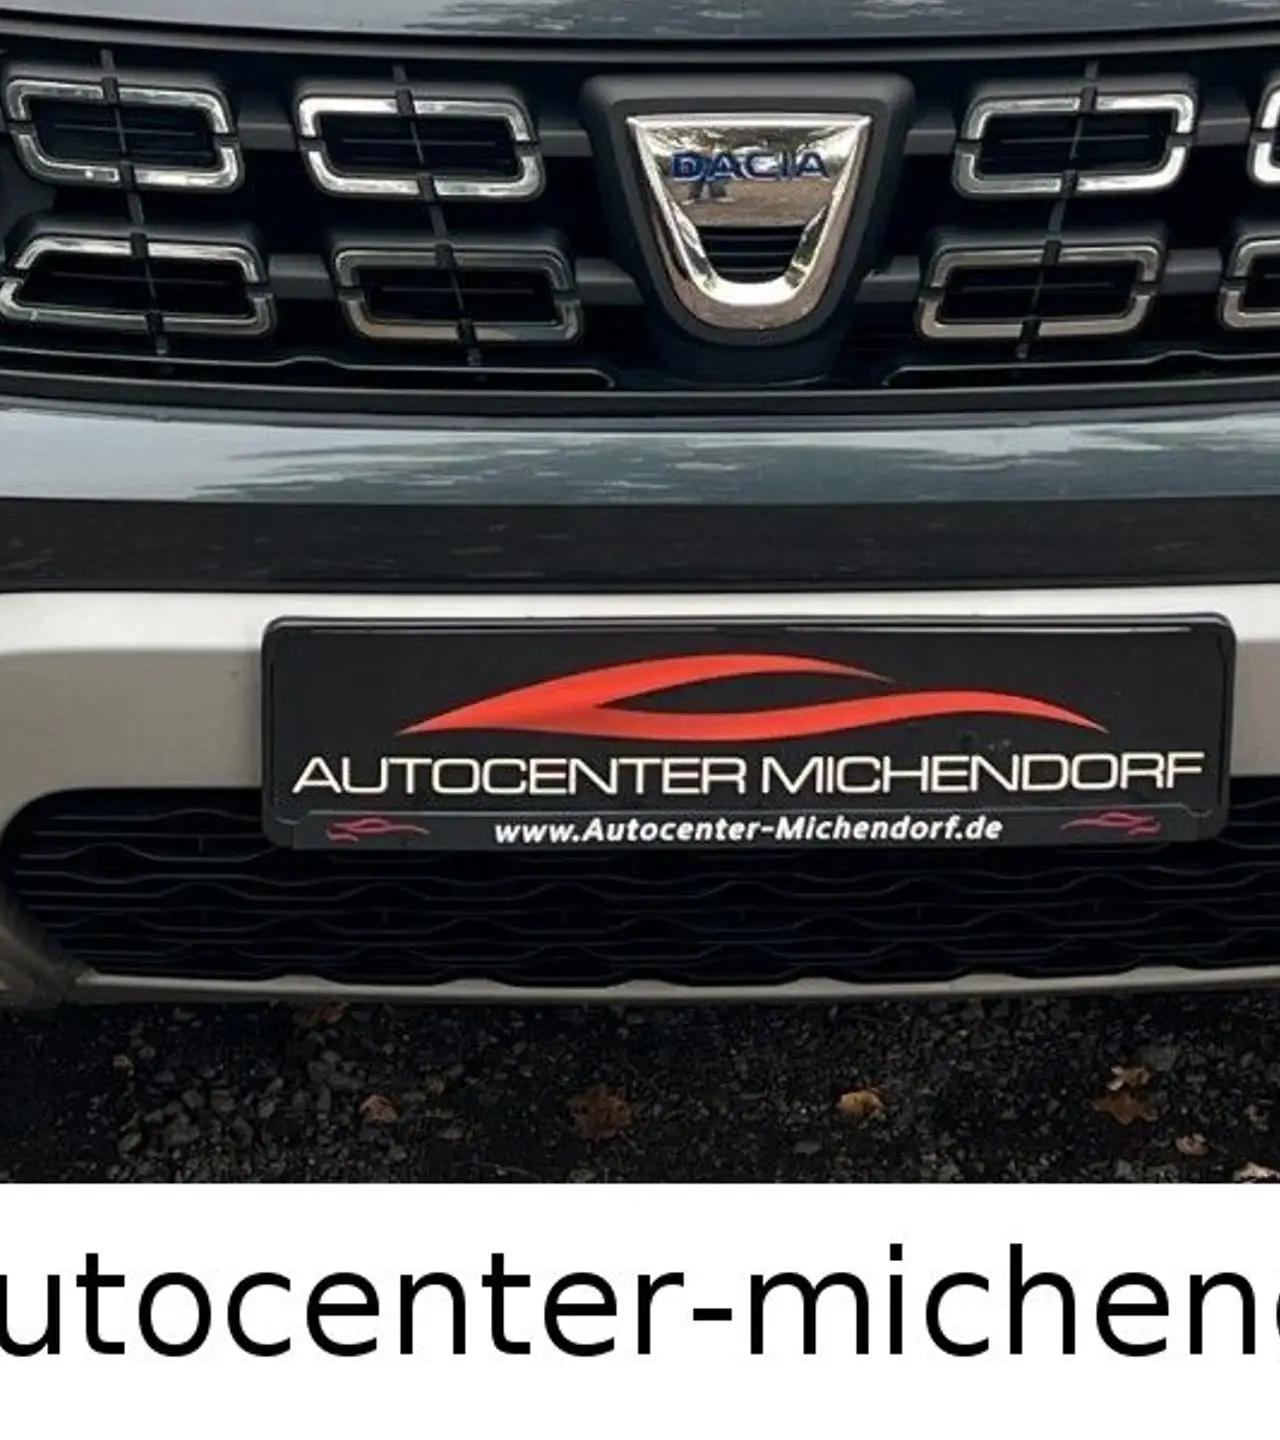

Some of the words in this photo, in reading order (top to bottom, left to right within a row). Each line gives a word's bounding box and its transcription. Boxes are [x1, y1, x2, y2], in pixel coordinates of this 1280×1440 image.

[670, 151, 829, 181] DACIA
[293, 754, 748, 796] AUTOCENTER
[761, 751, 1206, 795] MICHENDORF
[495, 811, 1004, 844] www.Autocenter-Michendorf.de
